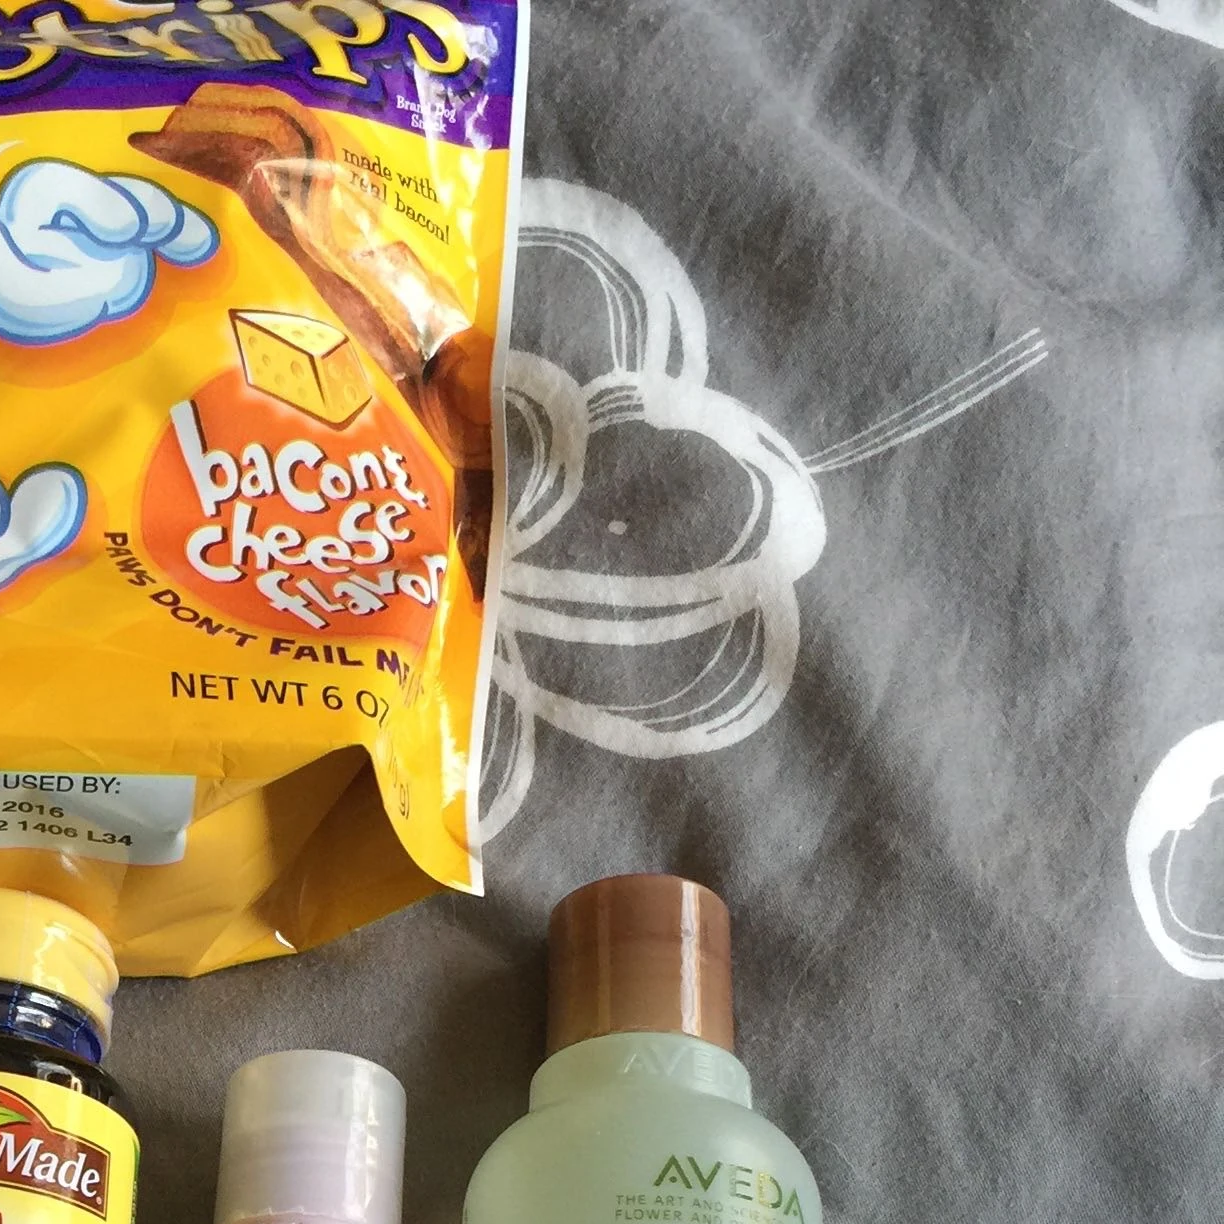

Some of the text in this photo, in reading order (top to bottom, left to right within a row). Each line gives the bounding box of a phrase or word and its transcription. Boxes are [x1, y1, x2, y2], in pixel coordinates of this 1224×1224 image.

[342, 147, 439, 204] made with
[394, 191, 451, 246] bacon!
[168, 399, 387, 518] bacon
[185, 500, 414, 583] cheese
[102, 530, 365, 668] PAWS DON'T FAIL
[170, 671, 240, 701] NET
[251, 677, 309, 707] WT
[320, 685, 344, 711] 6
[2, 773, 74, 793] USED
[81, 775, 123, 795] BY:
[1, 799, 65, 819] 2016
[17, 819, 79, 839] 1406
[86, 829, 134, 847] L34
[615, 1207, 682, 1222] FLOWER
